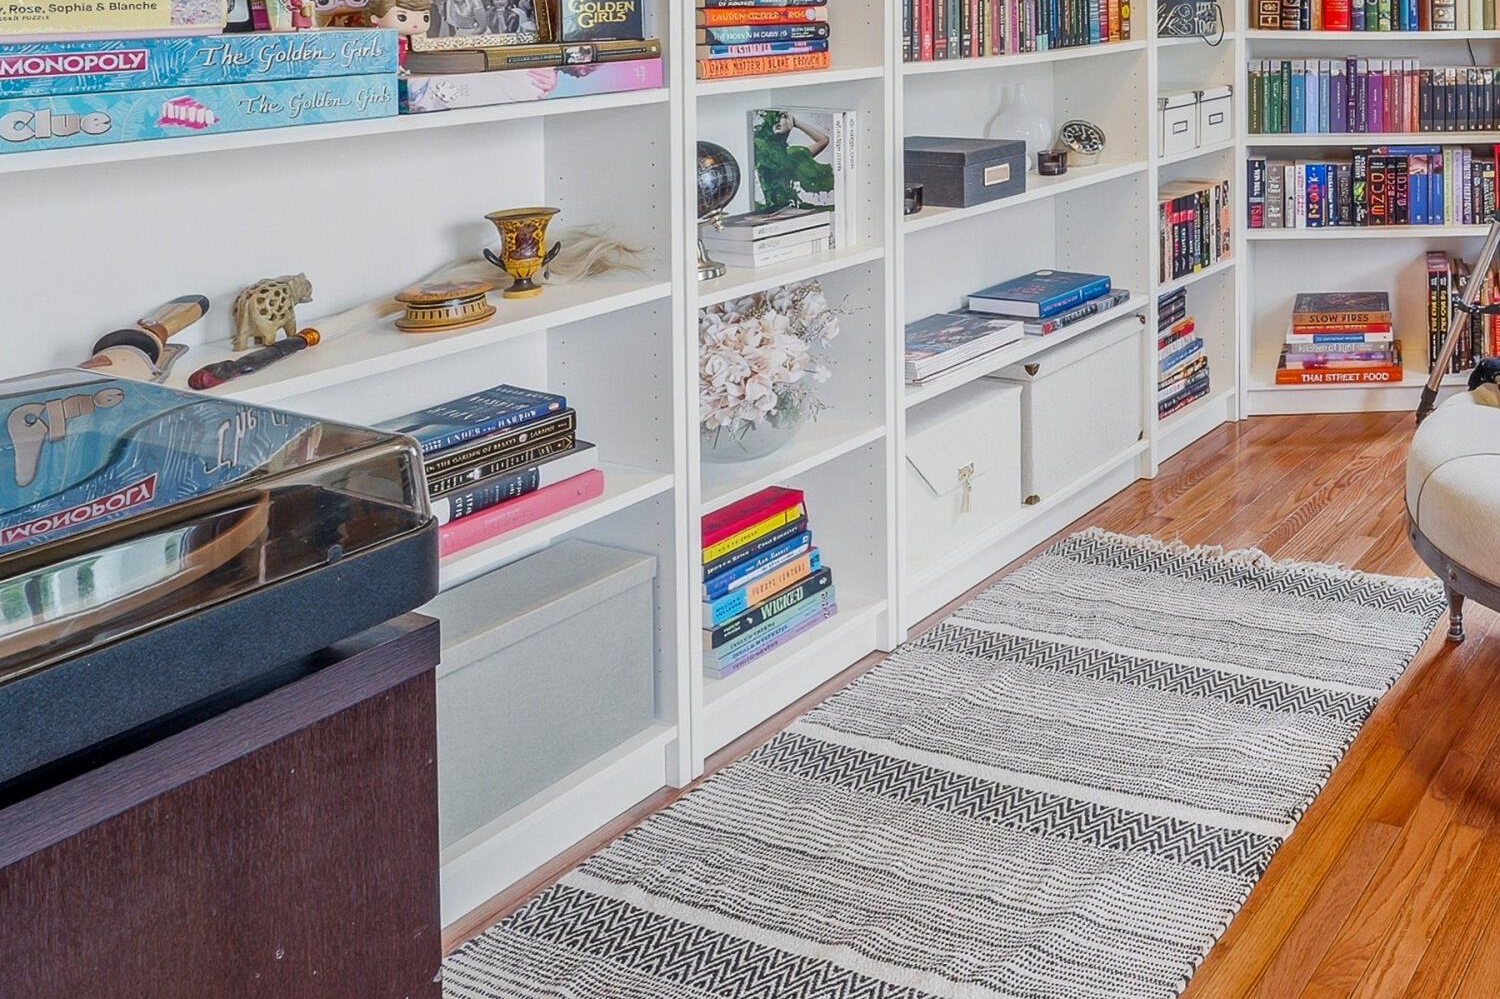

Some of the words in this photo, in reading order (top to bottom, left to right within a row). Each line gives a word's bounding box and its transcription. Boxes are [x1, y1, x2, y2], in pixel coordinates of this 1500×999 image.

[9, 4, 46, 15] Rose,
[48, 2, 93, 15] Sophia
[96, 2, 105, 12] &
[109, 1, 158, 12] Blanche
[577, 11, 628, 29] GIRLS
[1, 51, 145, 77] MONOPOLY
[197, 43, 255, 68] The
[258, 40, 337, 71] Golden
[340, 35, 385, 67] Girls
[1, 108, 113, 143] Clue
[237, 98, 285, 117] The
[288, 92, 352, 121] Golden
[355, 87, 392, 113] Girls
[1309, 314, 1338, 323] SLOW
[1301, 373, 1322, 382] THAI
[1325, 372, 1361, 382] STREET
[1363, 372, 1390, 381] FOOD
[446, 427, 481, 445] UNDER
[760, 586, 804, 620] WICKED
